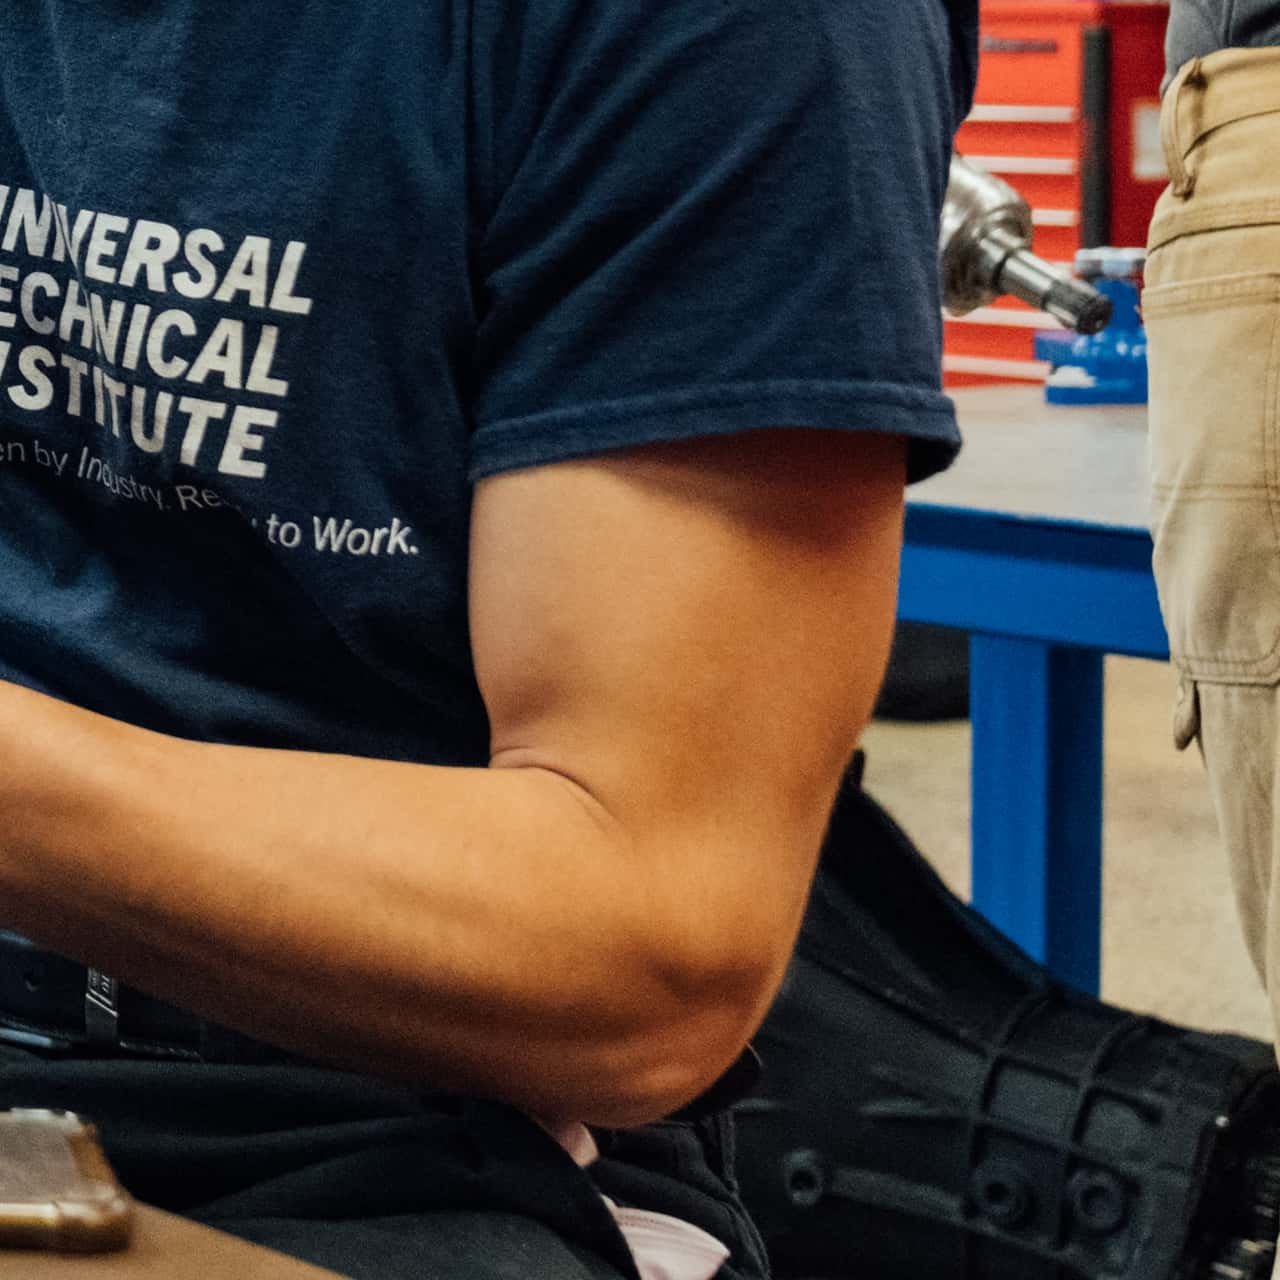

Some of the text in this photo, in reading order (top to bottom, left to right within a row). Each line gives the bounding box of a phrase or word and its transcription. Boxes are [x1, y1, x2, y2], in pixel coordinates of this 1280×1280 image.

[35, 440, 69, 476] by
[266, 513, 302, 548] to
[313, 516, 419, 556] Work.
